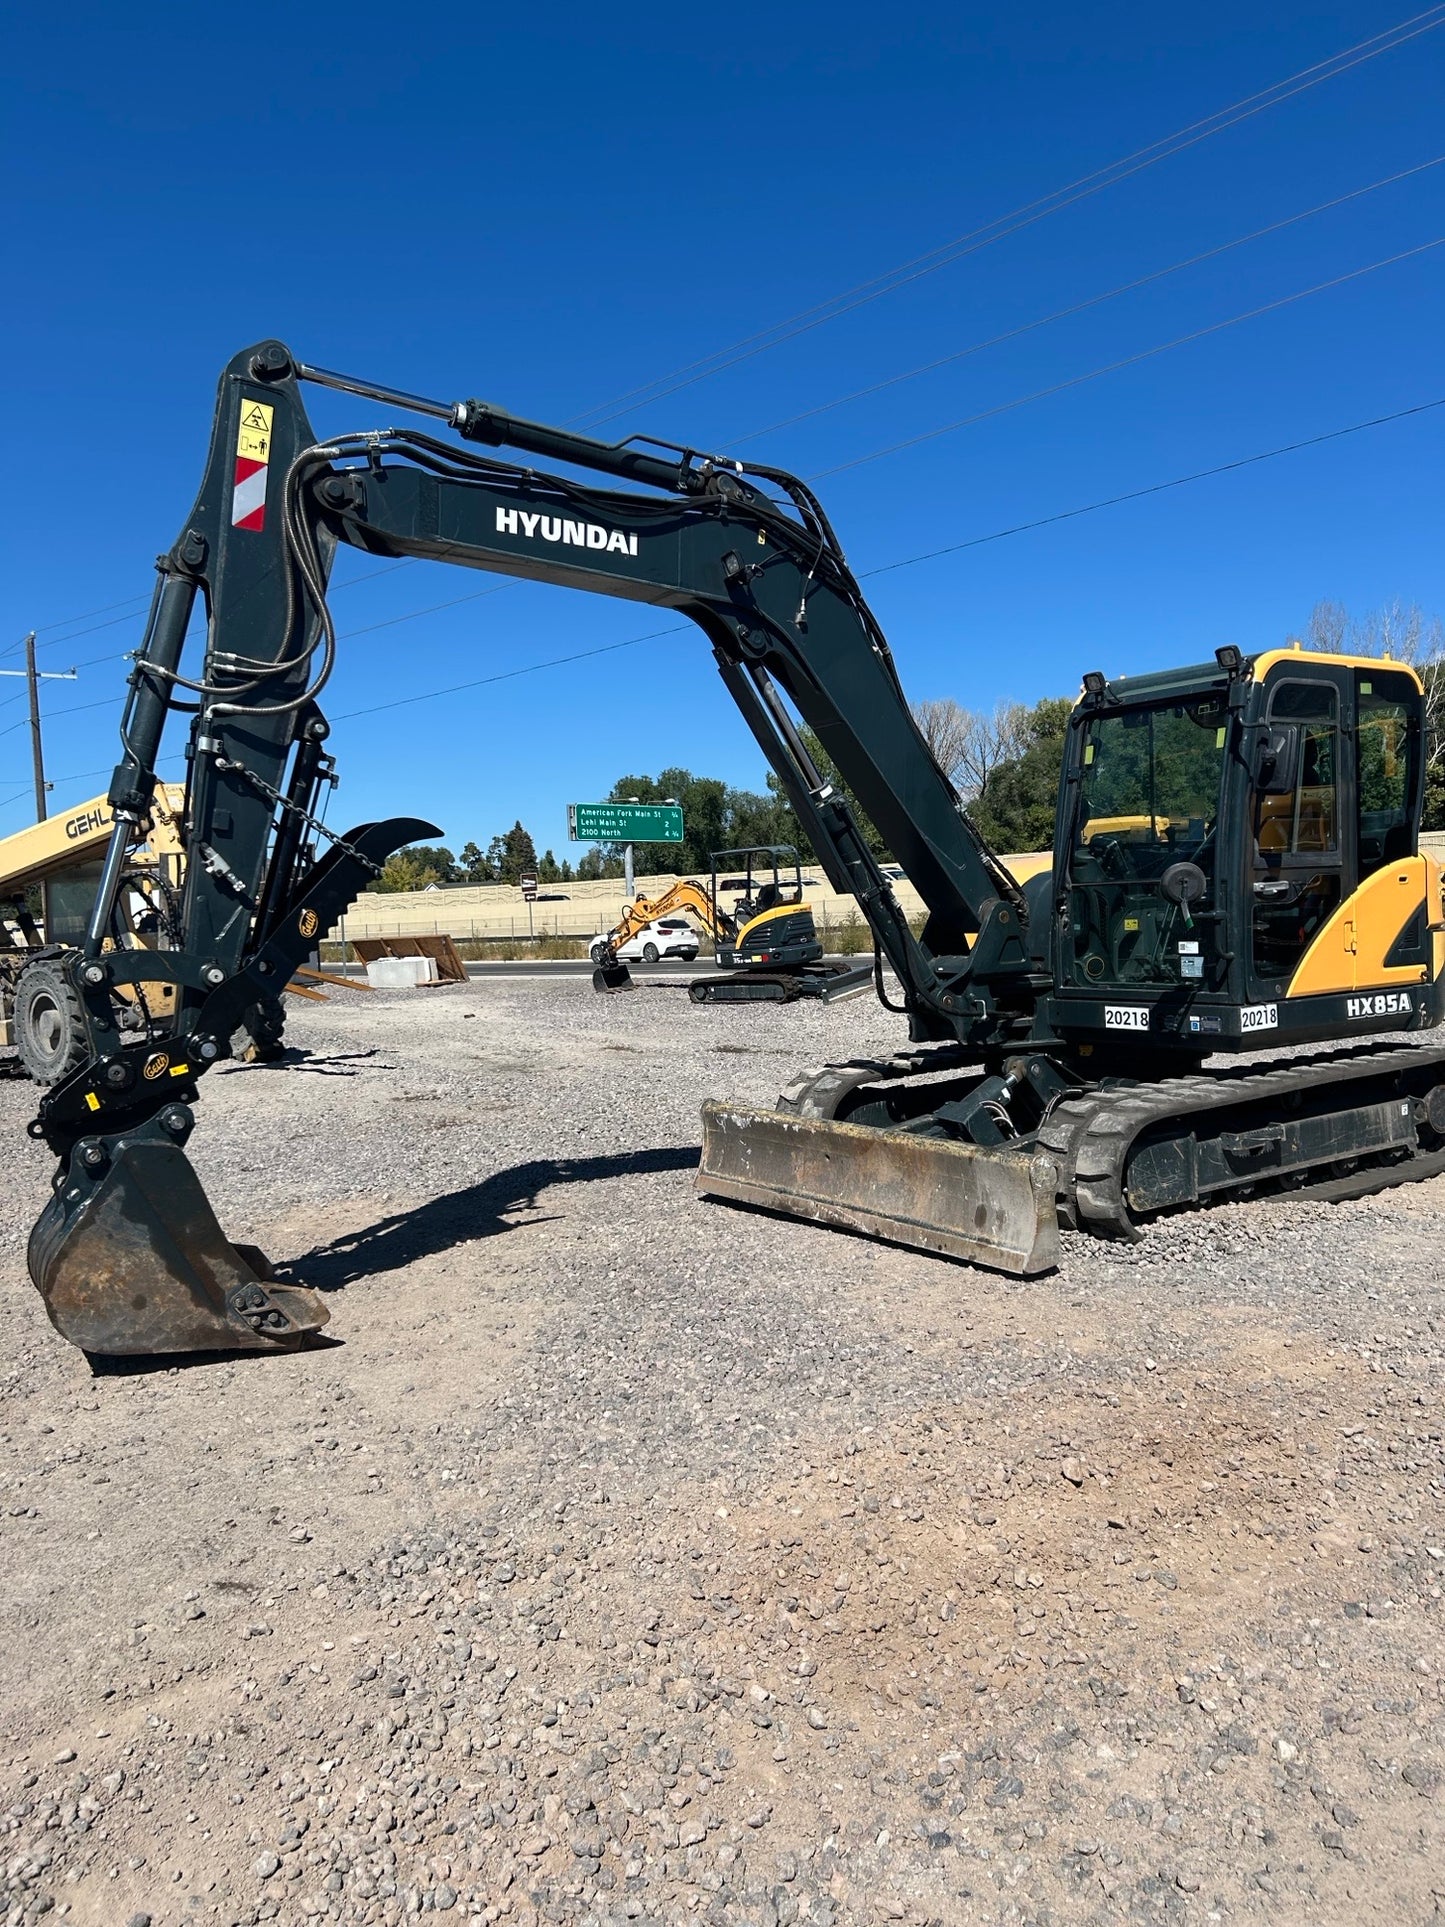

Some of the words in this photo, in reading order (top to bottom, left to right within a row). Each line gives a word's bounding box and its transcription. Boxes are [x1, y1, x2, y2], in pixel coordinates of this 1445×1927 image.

[496, 506, 638, 556] HYUNDAI
[580, 808, 615, 817] American
[617, 809, 633, 817] Fork
[635, 810, 651, 818] Main
[653, 810, 662, 818] St
[580, 818, 597, 826] Lehi
[600, 819, 617, 827] Main
[66, 808, 111, 839] GEHL
[581, 828, 599, 836] 2100
[601, 829, 622, 837] North
[1347, 993, 1412, 1018] HX85A
[1106, 1009, 1149, 1027] 20218
[1241, 1008, 1277, 1029] 20218
